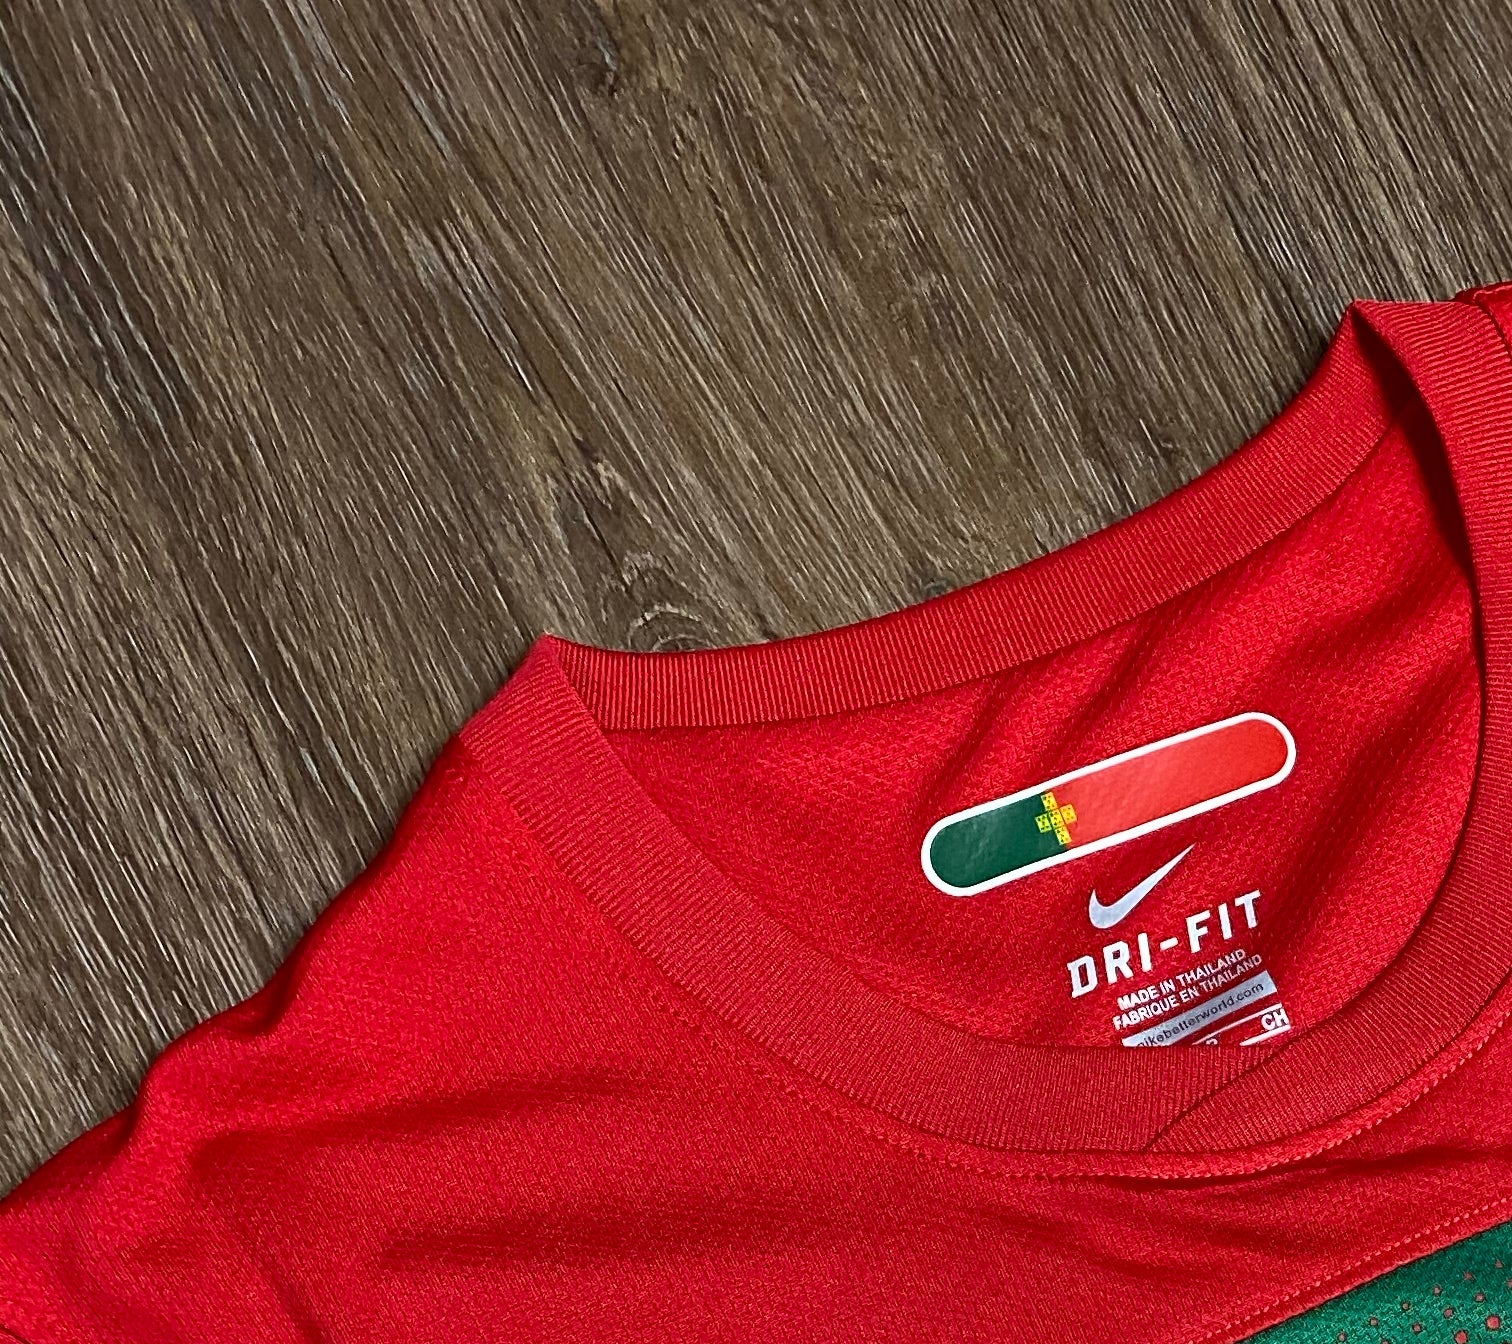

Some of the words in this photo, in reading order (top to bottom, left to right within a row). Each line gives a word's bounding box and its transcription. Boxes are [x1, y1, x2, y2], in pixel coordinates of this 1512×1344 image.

[1068, 890, 1260, 998] DRI-FIT
[1117, 985, 1161, 1010] MADE
[1159, 980, 1177, 998] IN
[1175, 949, 1247, 987] THAILAND
[1112, 996, 1180, 1031] FABRIQUE
[1181, 983, 1201, 1004] EN
[1200, 954, 1263, 993] THAILAND
